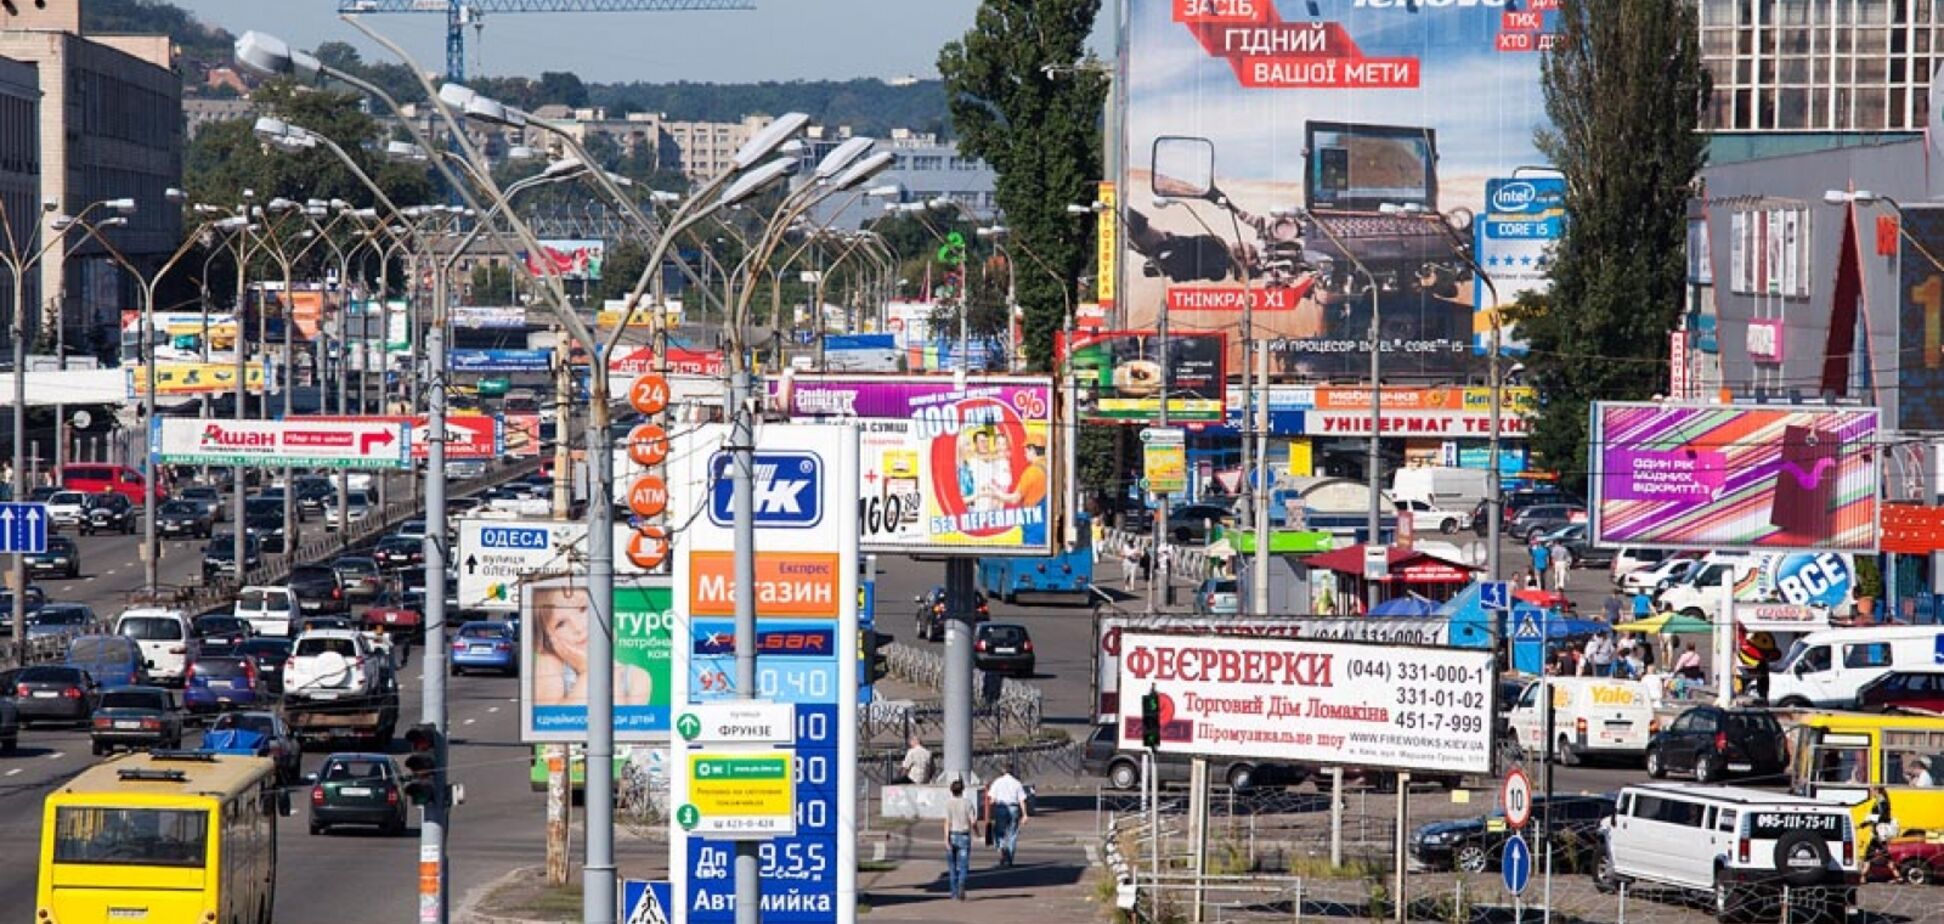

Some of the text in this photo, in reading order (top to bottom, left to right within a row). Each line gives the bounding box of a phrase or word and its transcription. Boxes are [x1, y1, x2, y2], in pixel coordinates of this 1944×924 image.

[1225, 21, 1326, 55] ГІДНИЙ
[1500, 34, 1528, 48] ХТО
[1254, 58, 1409, 83] ВАШОЇ МЕТИ
[1499, 223, 1532, 236] CORE
[1264, 291, 1285, 308] X1
[637, 383, 665, 405] 24
[636, 436, 666, 456] WC
[633, 488, 666, 504] ATM
[484, 529, 545, 547] ОДЕСА
[779, 561, 830, 574] Експрес
[698, 575, 832, 603] Маазин
[1778, 551, 1847, 608] ВСЕ
[1126, 646, 1334, 688] ФЕЄРВЕРКИ
[1346, 659, 1484, 685] (044) 331-000-1
[1395, 686, 1485, 710] 331-01-02
[1590, 685, 1633, 705] Yale
[1183, 691, 1390, 723] Торговий Дім Ломакіна
[718, 725, 772, 737] ФРУНЗЕ
[1394, 710, 1483, 734] 451-7-999
[1197, 722, 1312, 745] Піромузикальне
[1316, 733, 1346, 751] шоу
[1511, 788, 1523, 811] 10
[1757, 813, 1836, 830] 095-111-75-11
